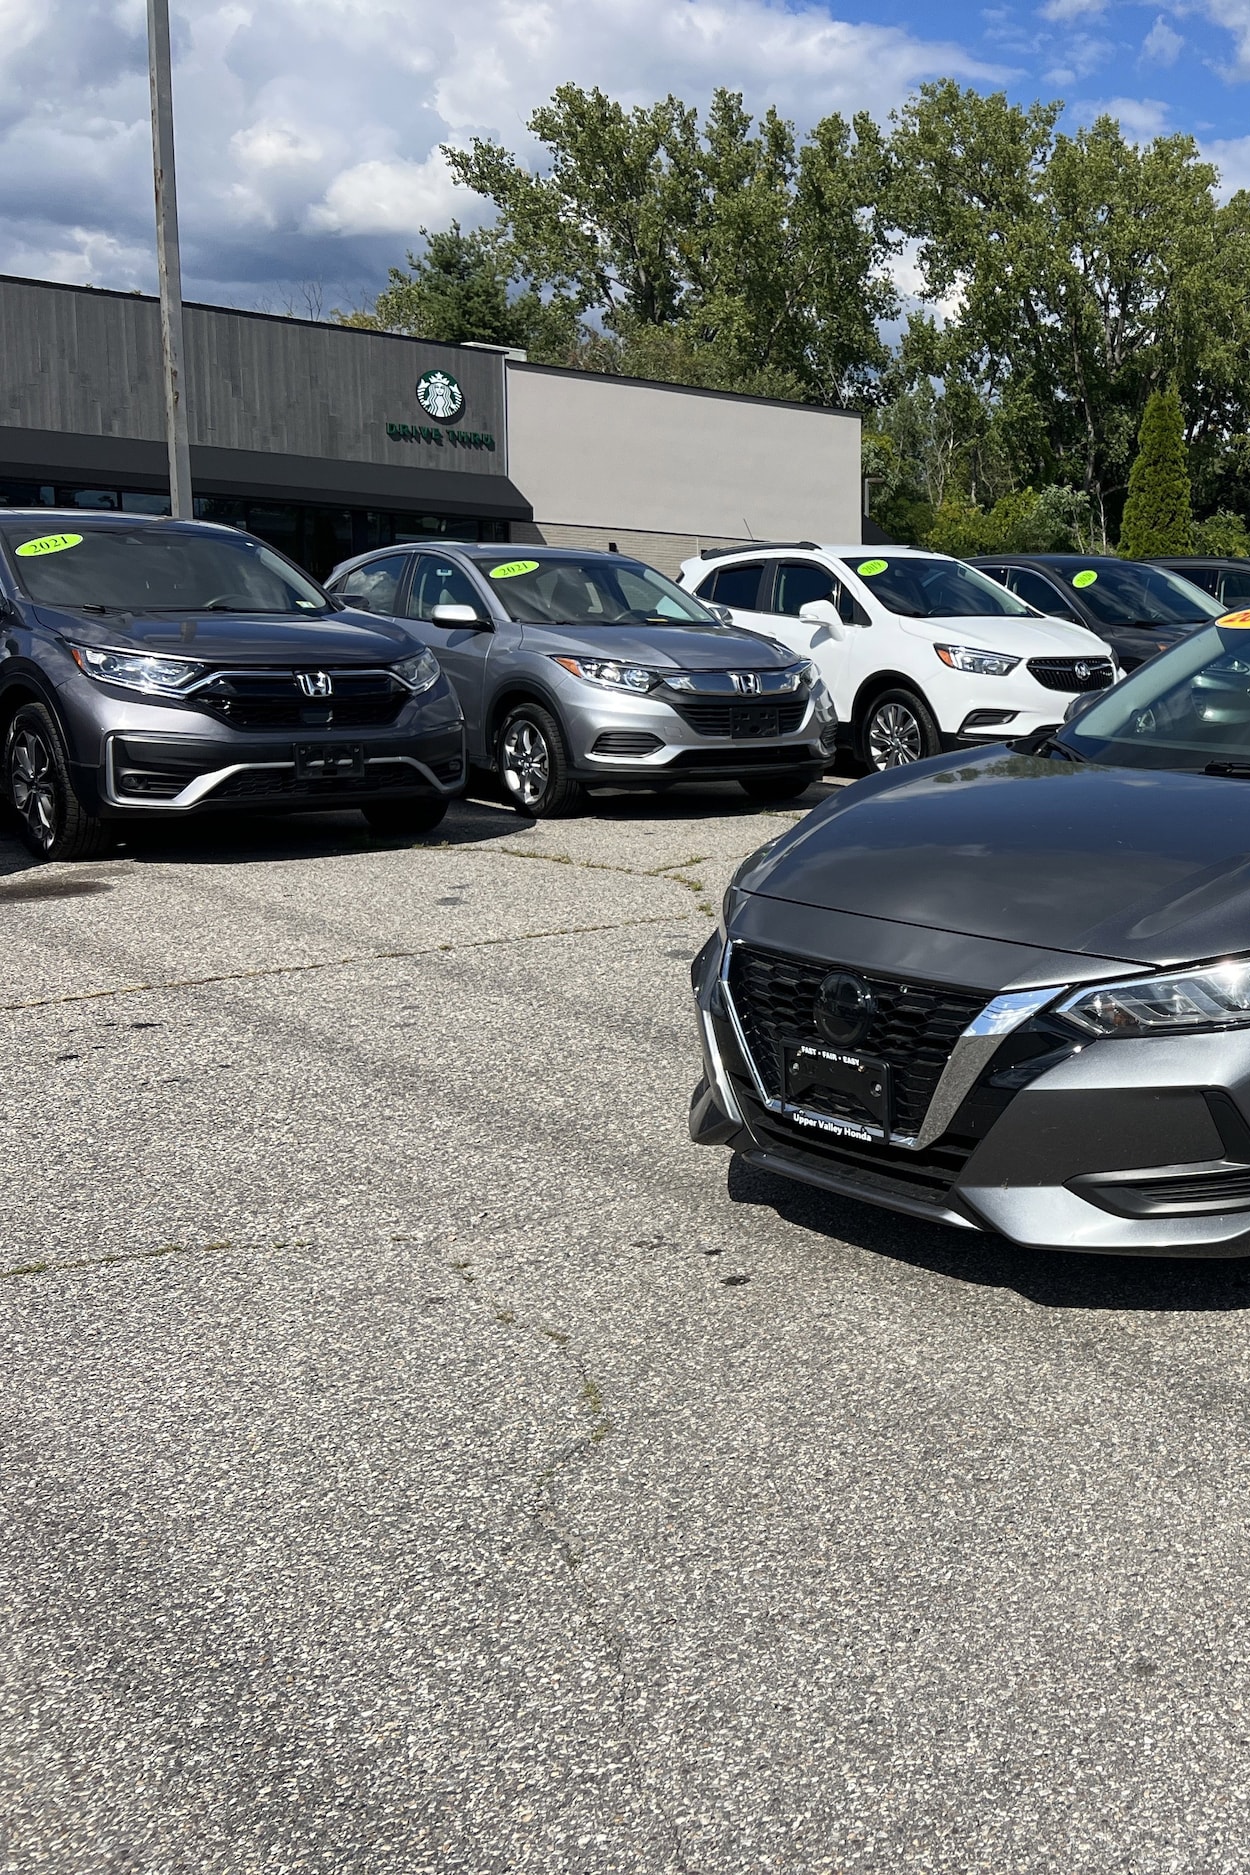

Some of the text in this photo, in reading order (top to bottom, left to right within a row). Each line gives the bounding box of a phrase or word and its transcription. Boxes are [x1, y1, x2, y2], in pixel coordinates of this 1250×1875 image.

[385, 423, 495, 445] DRIVE THRU
[28, 536, 68, 553] 2021
[500, 562, 528, 576] 2021
[801, 1045, 860, 1067] FAST FAIR EASY
[793, 1113, 872, 1142] Upper Valley Honda
